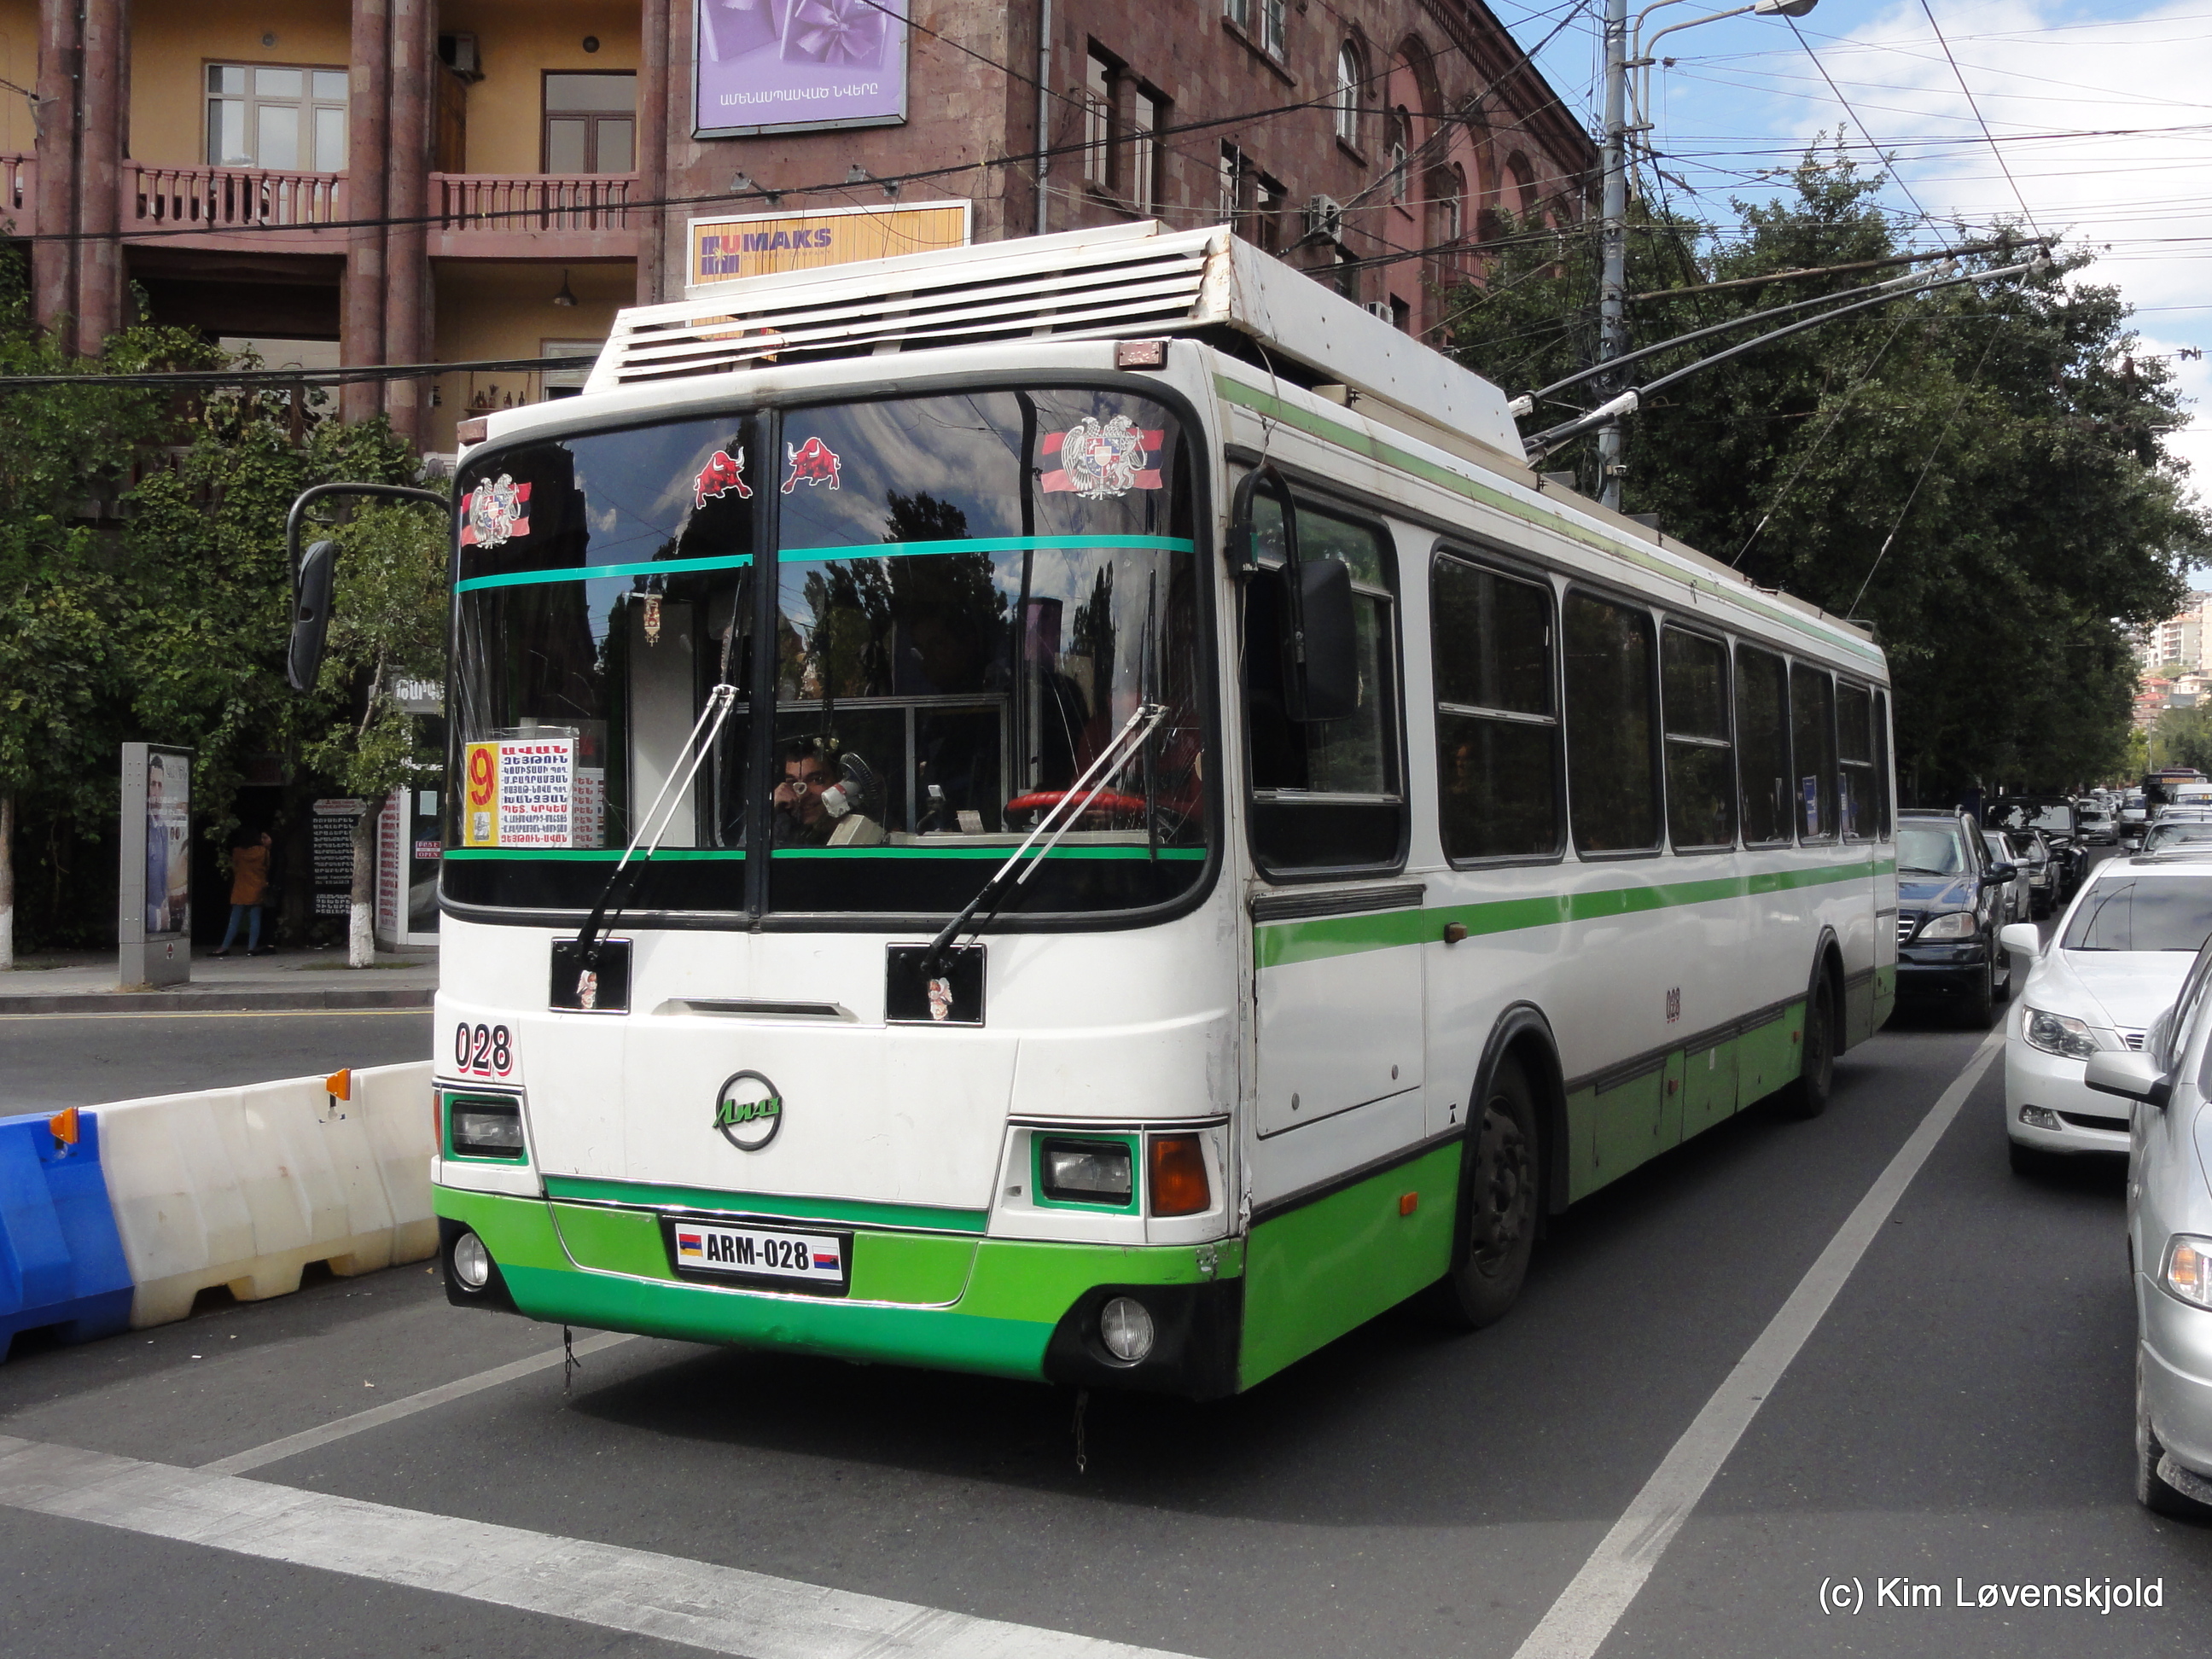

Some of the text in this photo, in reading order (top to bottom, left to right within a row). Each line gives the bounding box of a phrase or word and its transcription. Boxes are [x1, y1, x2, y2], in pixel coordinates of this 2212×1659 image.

[720, 83, 878, 106] ԱՄԵՆԱՍՊԱՍՎԱԾ ՆՎԵՐԸ
[502, 746, 568, 755] ԱՎԱՆ
[470, 748, 495, 806] 9
[1666, 987, 1680, 1024] 028
[455, 1022, 514, 1077] 028
[707, 1234, 809, 1271] ARM-028
